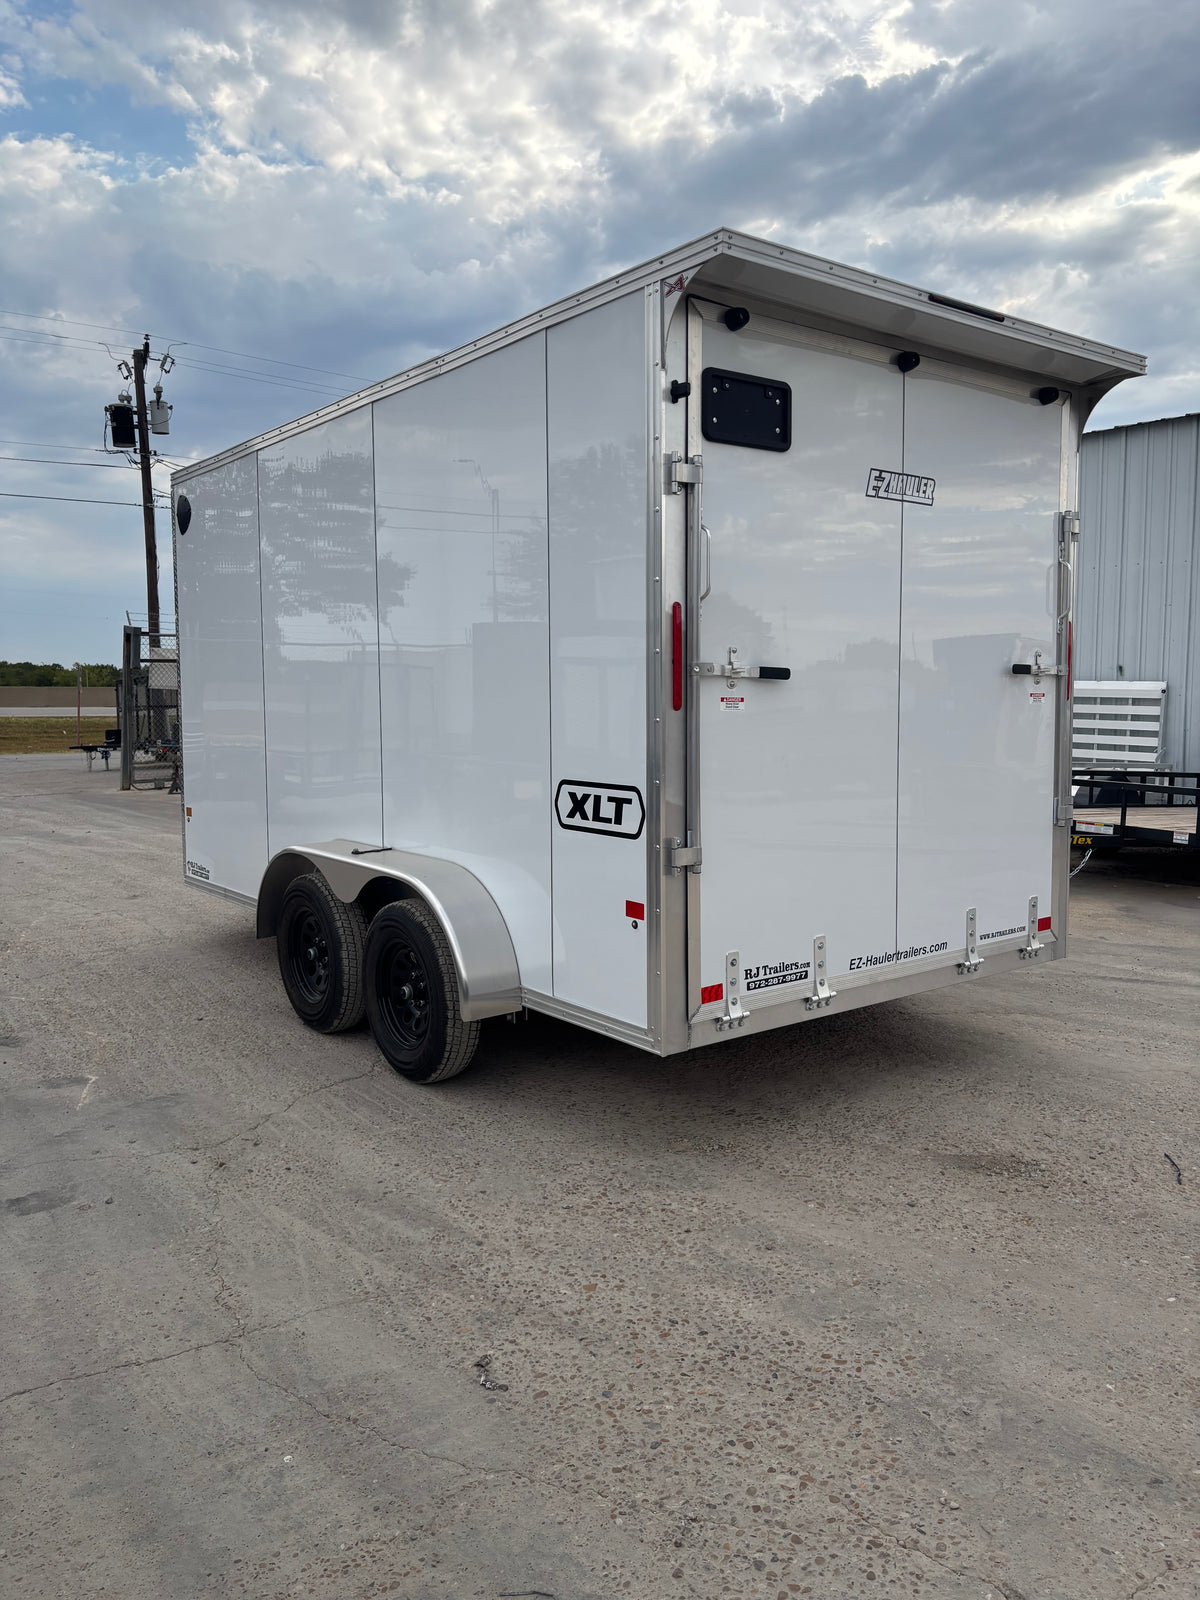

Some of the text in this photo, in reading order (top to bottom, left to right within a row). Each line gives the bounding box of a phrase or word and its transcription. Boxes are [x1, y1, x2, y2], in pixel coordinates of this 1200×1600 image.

[566, 791, 633, 826] XLT
[849, 941, 948, 970] EZ-Haulertrailers.com
[744, 966, 761, 980] RJ
[749, 972, 806, 989] 972-287-9977
